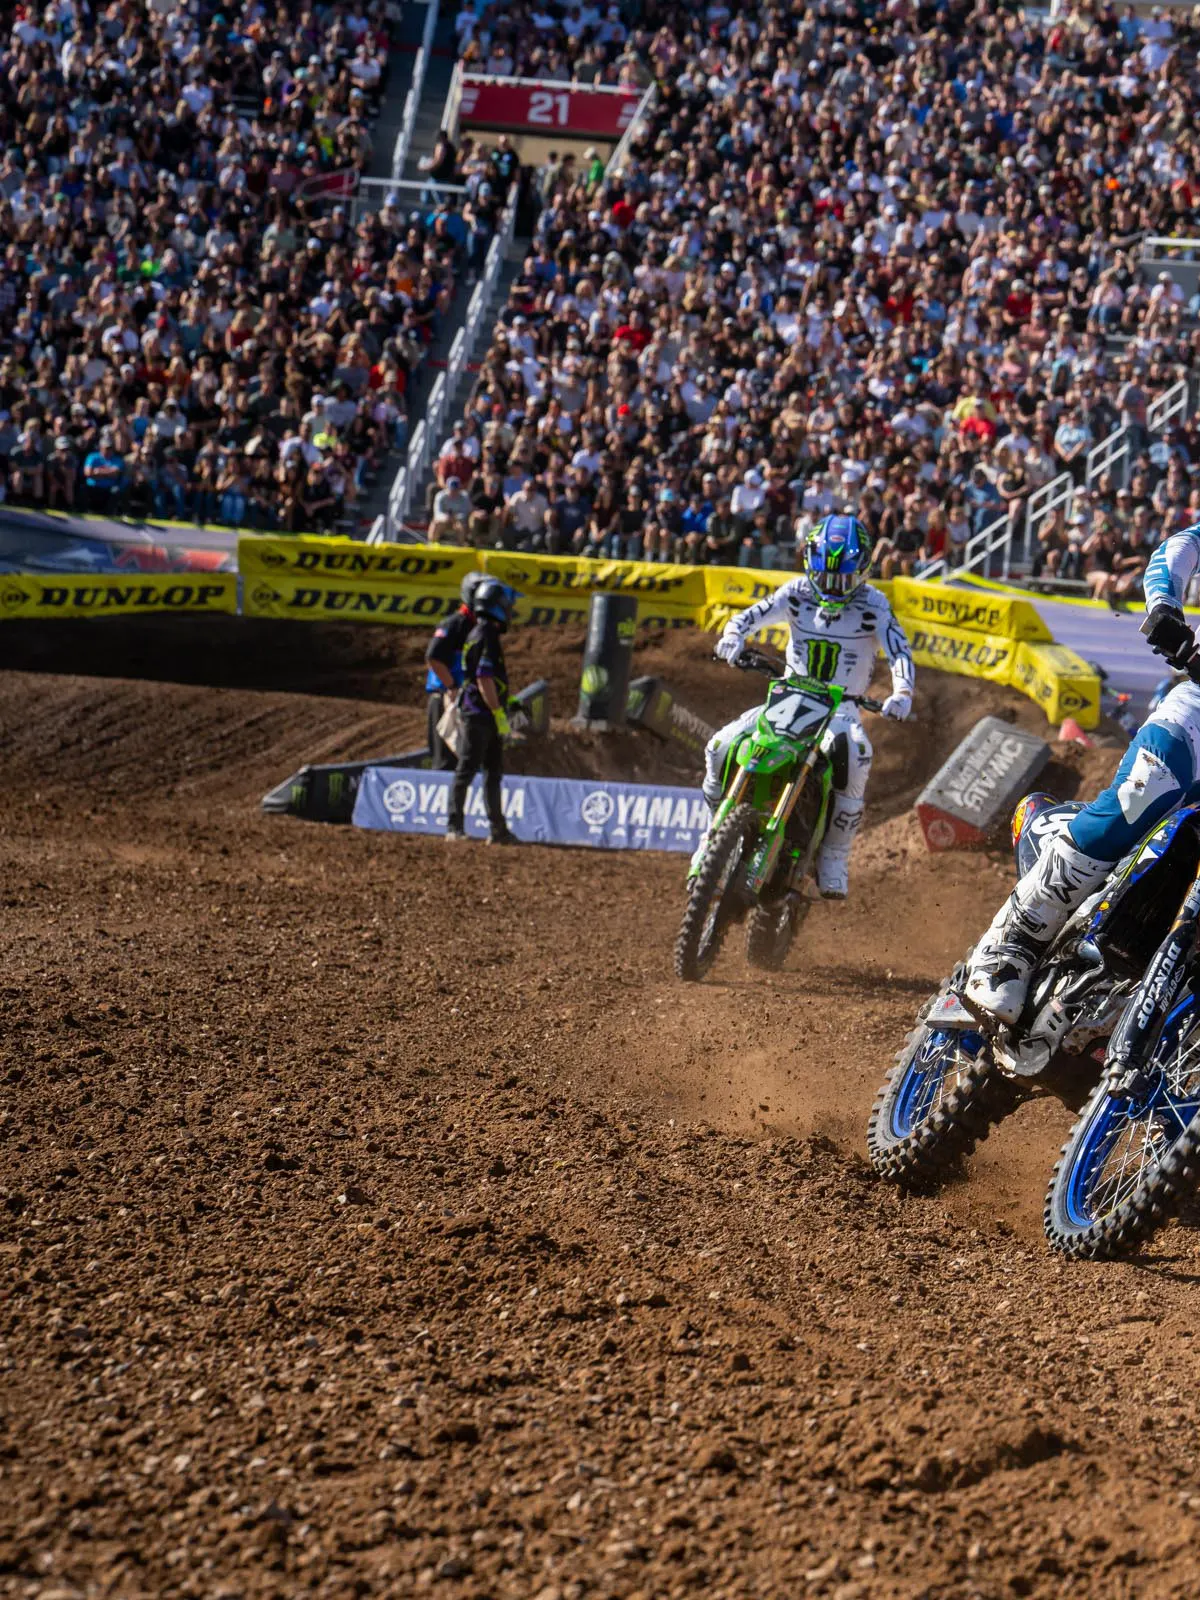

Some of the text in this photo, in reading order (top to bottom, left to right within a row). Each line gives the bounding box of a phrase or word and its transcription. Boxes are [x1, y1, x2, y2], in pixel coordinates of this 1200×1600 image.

[527, 91, 569, 125] 21
[292, 551, 454, 575] DUNLOP
[36, 585, 226, 607] DUNLOP
[537, 569, 684, 592] DUNLOP
[922, 596, 1000, 626] DUNLOP
[910, 631, 1009, 668] DUNLOP
[765, 693, 830, 734] 47
[617, 795, 709, 829] YAMAH
[1137, 941, 1182, 1029] DUNLOP
